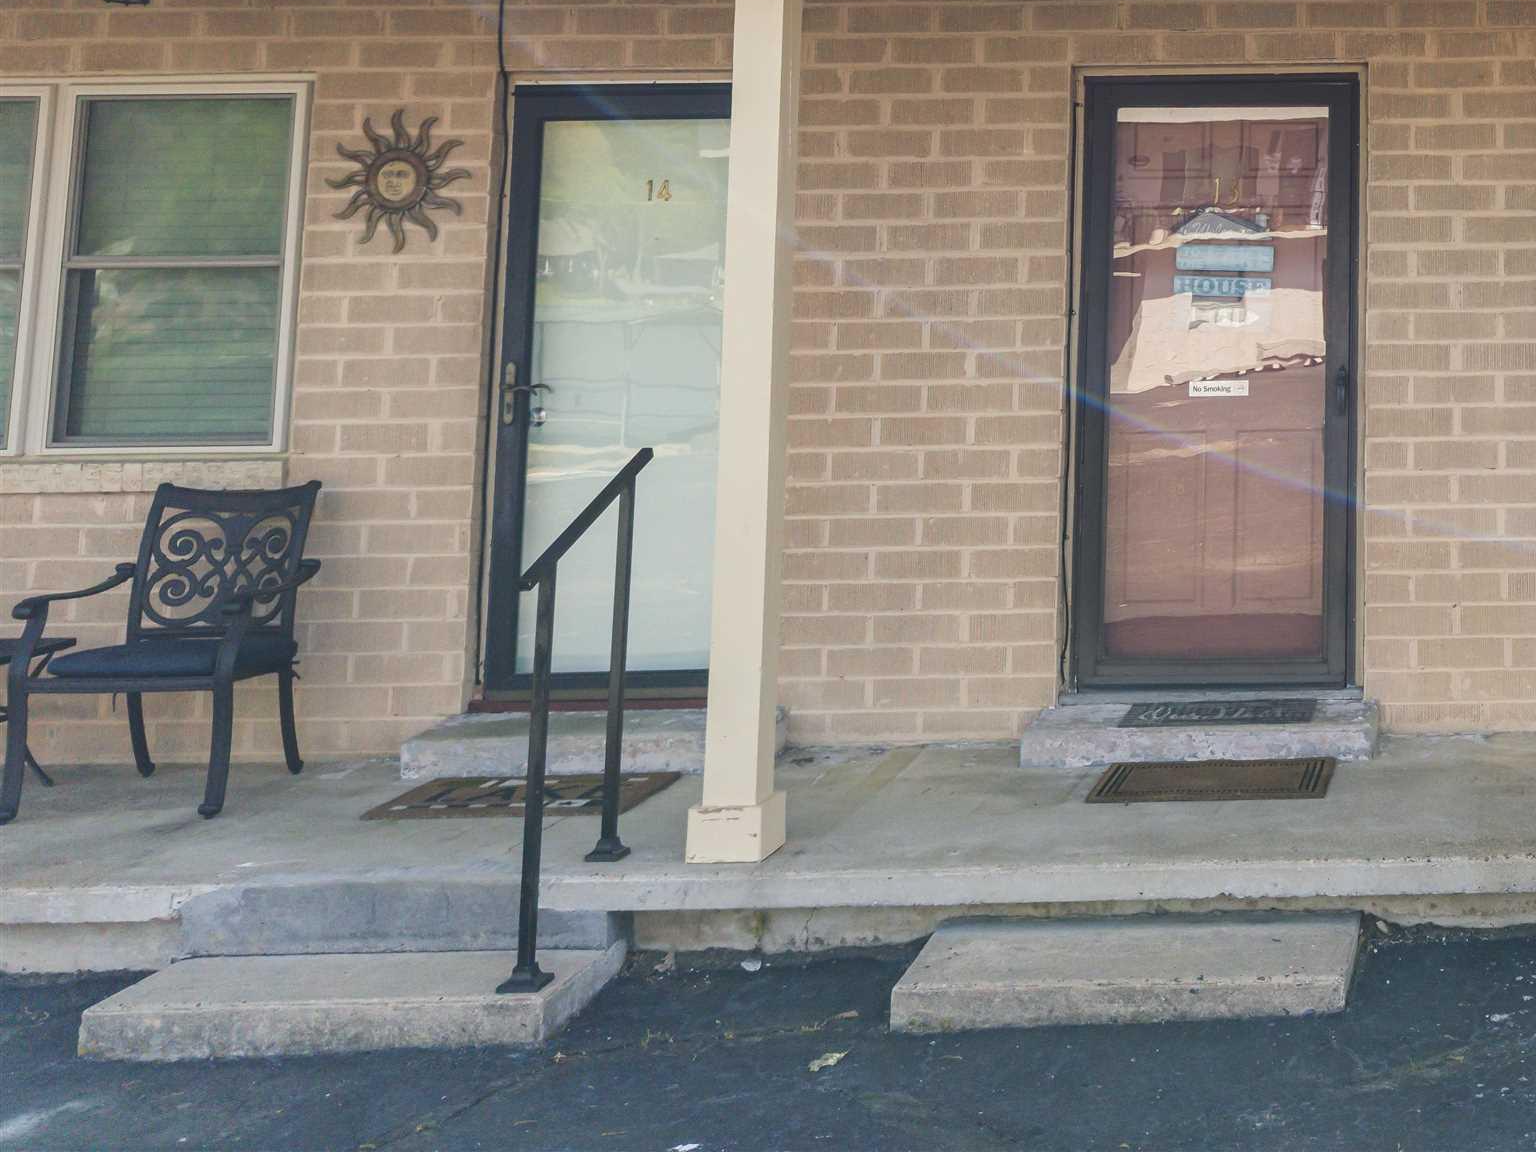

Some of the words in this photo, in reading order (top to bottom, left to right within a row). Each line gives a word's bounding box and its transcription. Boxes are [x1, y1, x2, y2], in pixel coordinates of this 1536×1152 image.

[647, 179, 672, 202] 14
[1193, 385, 1202, 393] No
[1203, 384, 1232, 394] Smoking
